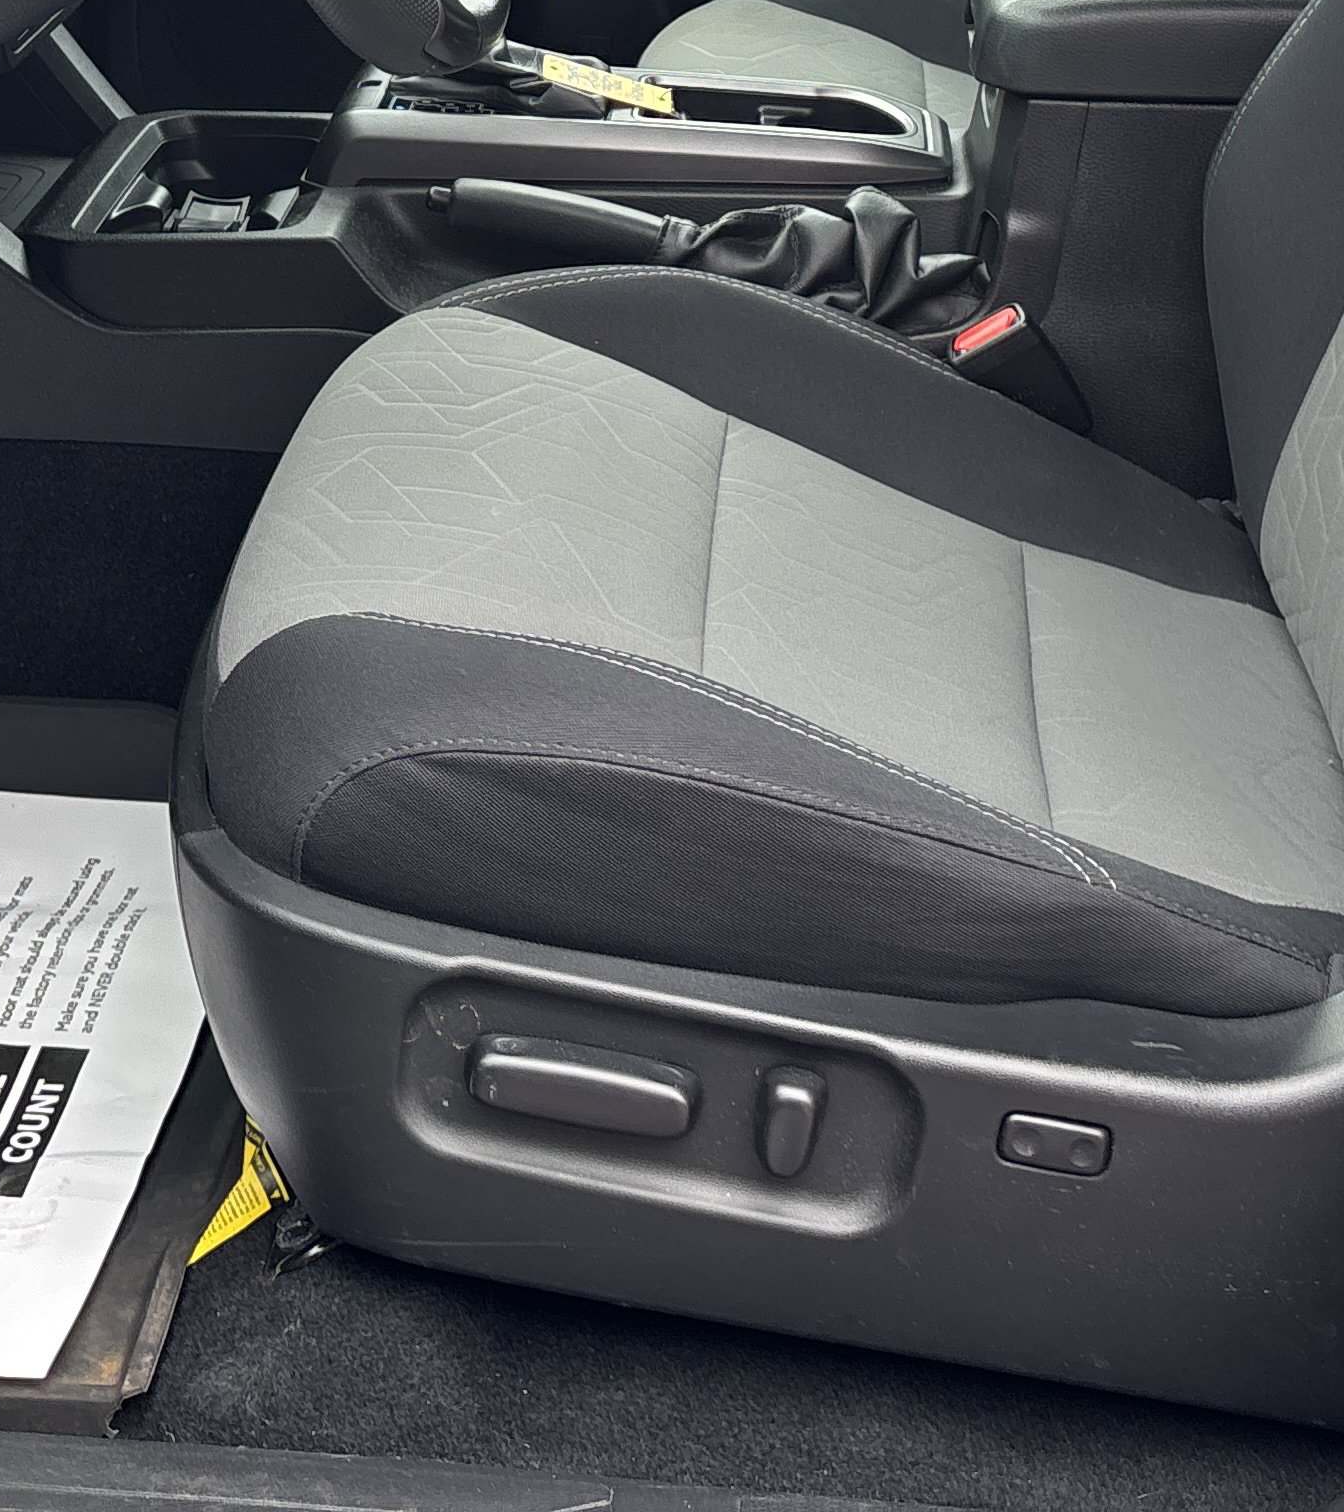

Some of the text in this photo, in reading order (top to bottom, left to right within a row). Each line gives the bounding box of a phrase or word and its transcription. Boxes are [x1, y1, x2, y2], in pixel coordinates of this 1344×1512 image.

[87, 930, 108, 955] have
[105, 933, 131, 970] double
[11, 975, 29, 996] mat
[20, 940, 44, 975] should
[84, 956, 98, 976] you
[26, 969, 57, 1008] factory
[71, 976, 88, 999] sure
[88, 972, 115, 1008] NEVER
[19, 1010, 37, 1029] the
[55, 1001, 78, 1032] Make
[82, 1010, 99, 1034] and
[1, 1078, 65, 1163] COUNT
